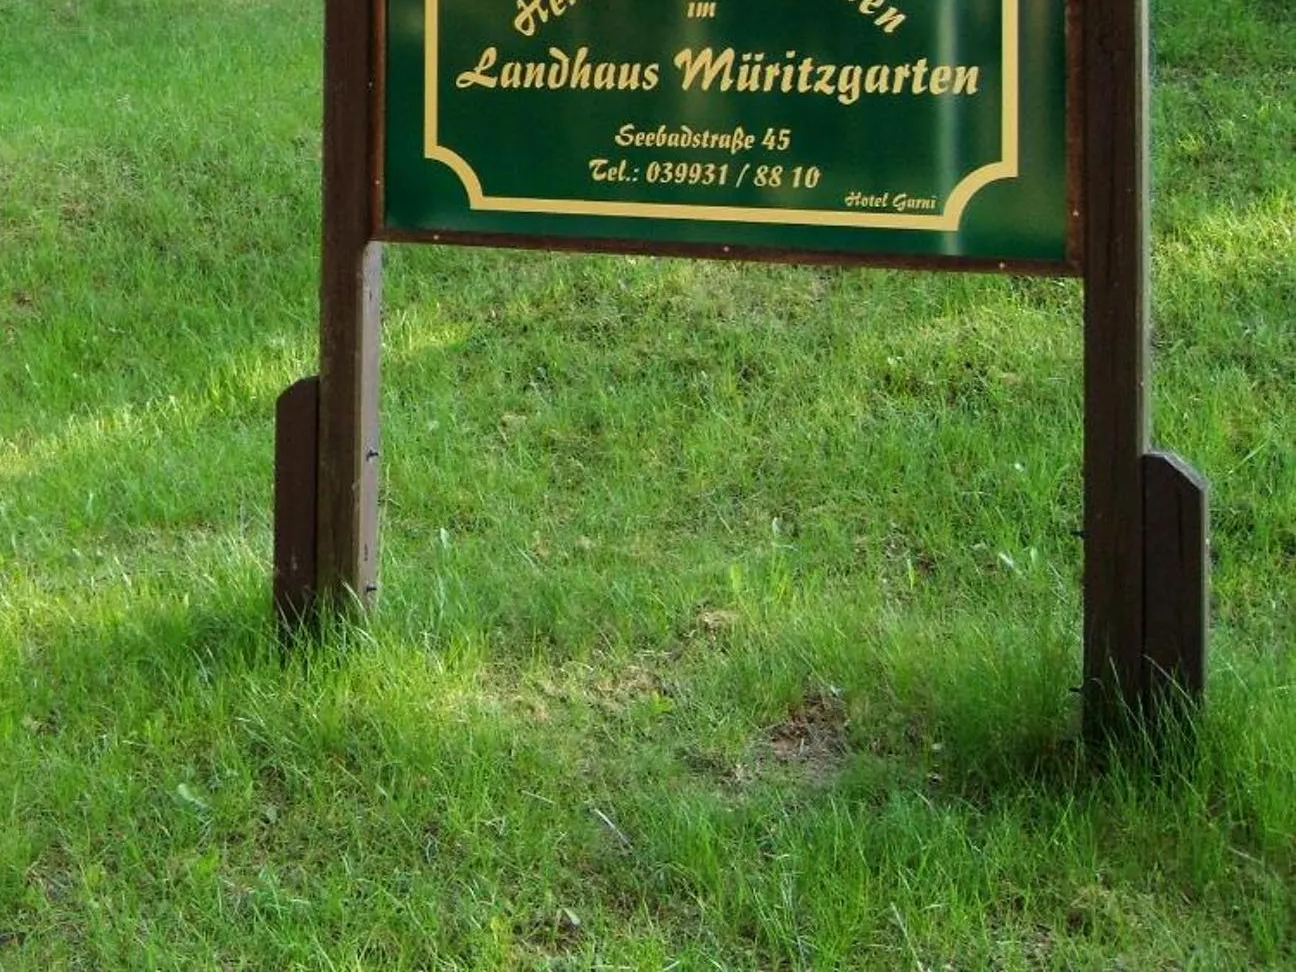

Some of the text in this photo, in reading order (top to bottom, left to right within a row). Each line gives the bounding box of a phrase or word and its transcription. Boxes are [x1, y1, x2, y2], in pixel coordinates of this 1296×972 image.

[455, 46, 980, 105] Landhaus Müritzgarten
[614, 123, 792, 155] Seebadstraße 45
[589, 159, 822, 189] Tel.: 039931 / 88 10
[844, 191, 938, 212] Hotel Garni
